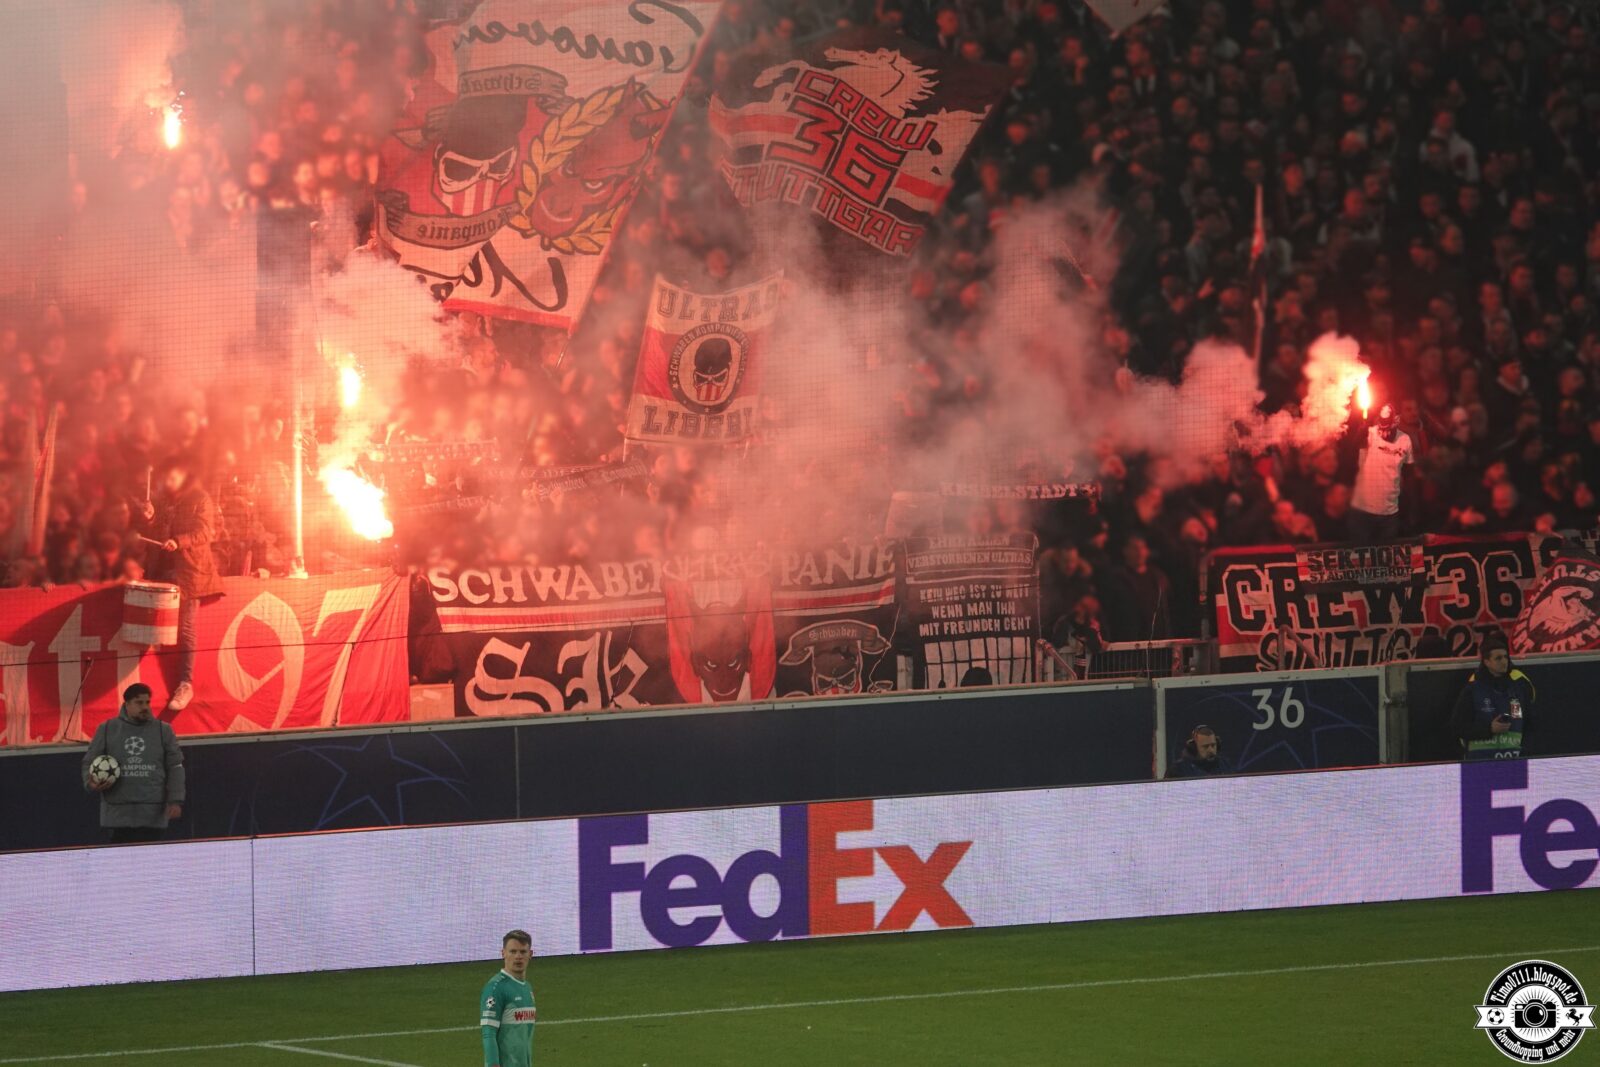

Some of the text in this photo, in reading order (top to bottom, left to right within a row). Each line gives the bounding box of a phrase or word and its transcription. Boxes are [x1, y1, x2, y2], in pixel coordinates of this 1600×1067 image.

[796, 70, 938, 151] CREW
[766, 98, 908, 207] 36
[722, 160, 925, 257] TUTTGAR
[657, 282, 779, 322] ULTRAS
[1222, 562, 1433, 636] CREW
[1434, 551, 1525, 624] 36
[1307, 544, 1413, 573] SEKTION
[919, 616, 1032, 637] MIT FREUNDEN GEHT
[931, 604, 963, 619] WENN
[967, 602, 993, 617] MAN
[218, 584, 382, 732] 97
[1251, 686, 1305, 732] 36
[1461, 760, 1600, 895] Fe
[577, 799, 975, 951] FedEx
